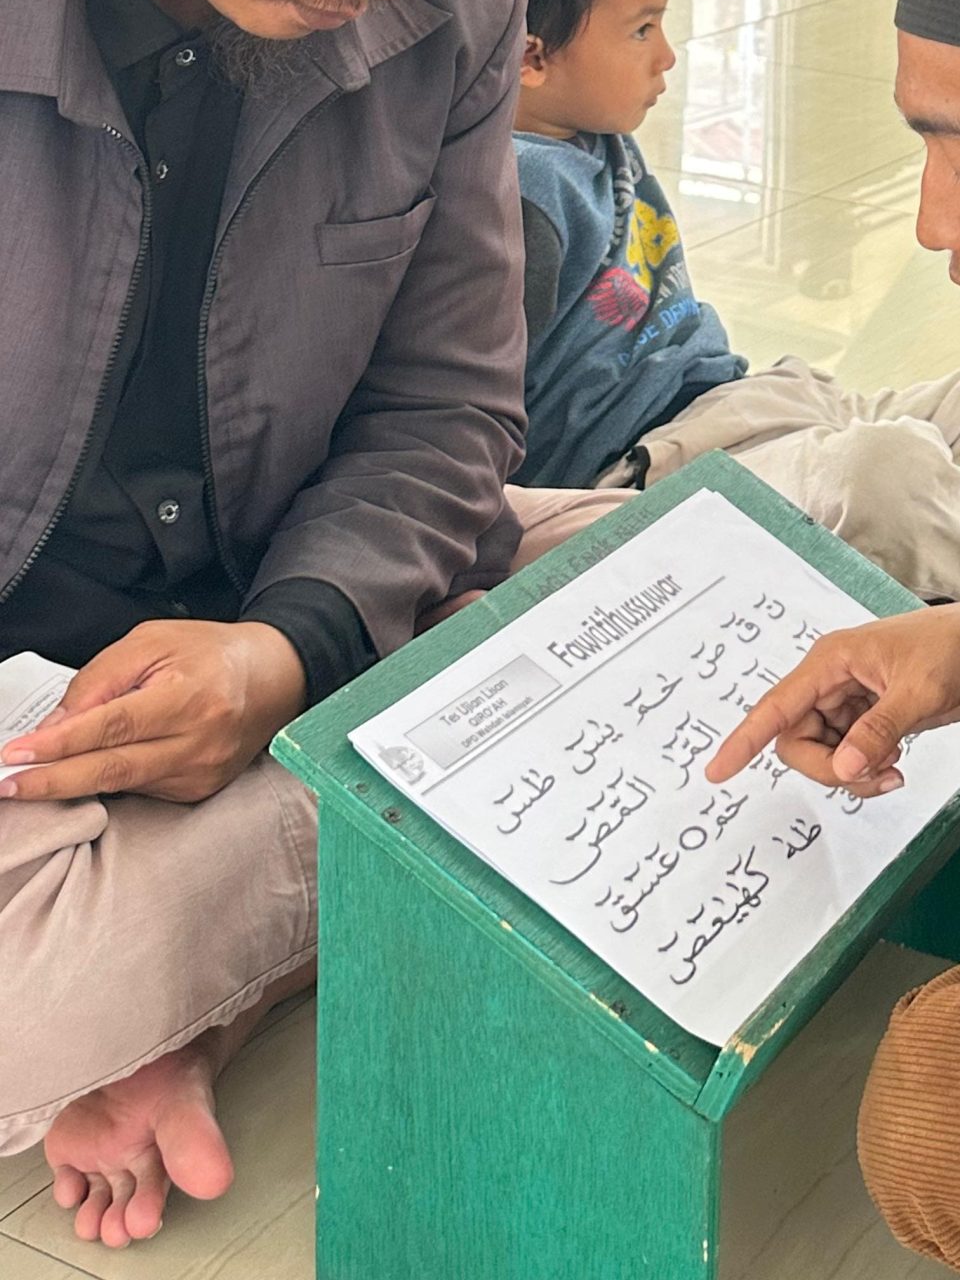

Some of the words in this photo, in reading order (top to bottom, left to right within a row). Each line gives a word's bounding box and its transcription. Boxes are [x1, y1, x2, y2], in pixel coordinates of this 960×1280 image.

[441, 713, 461, 726] Tes
[460, 697, 485, 718] Ujian
[482, 679, 508, 700] Lisan
